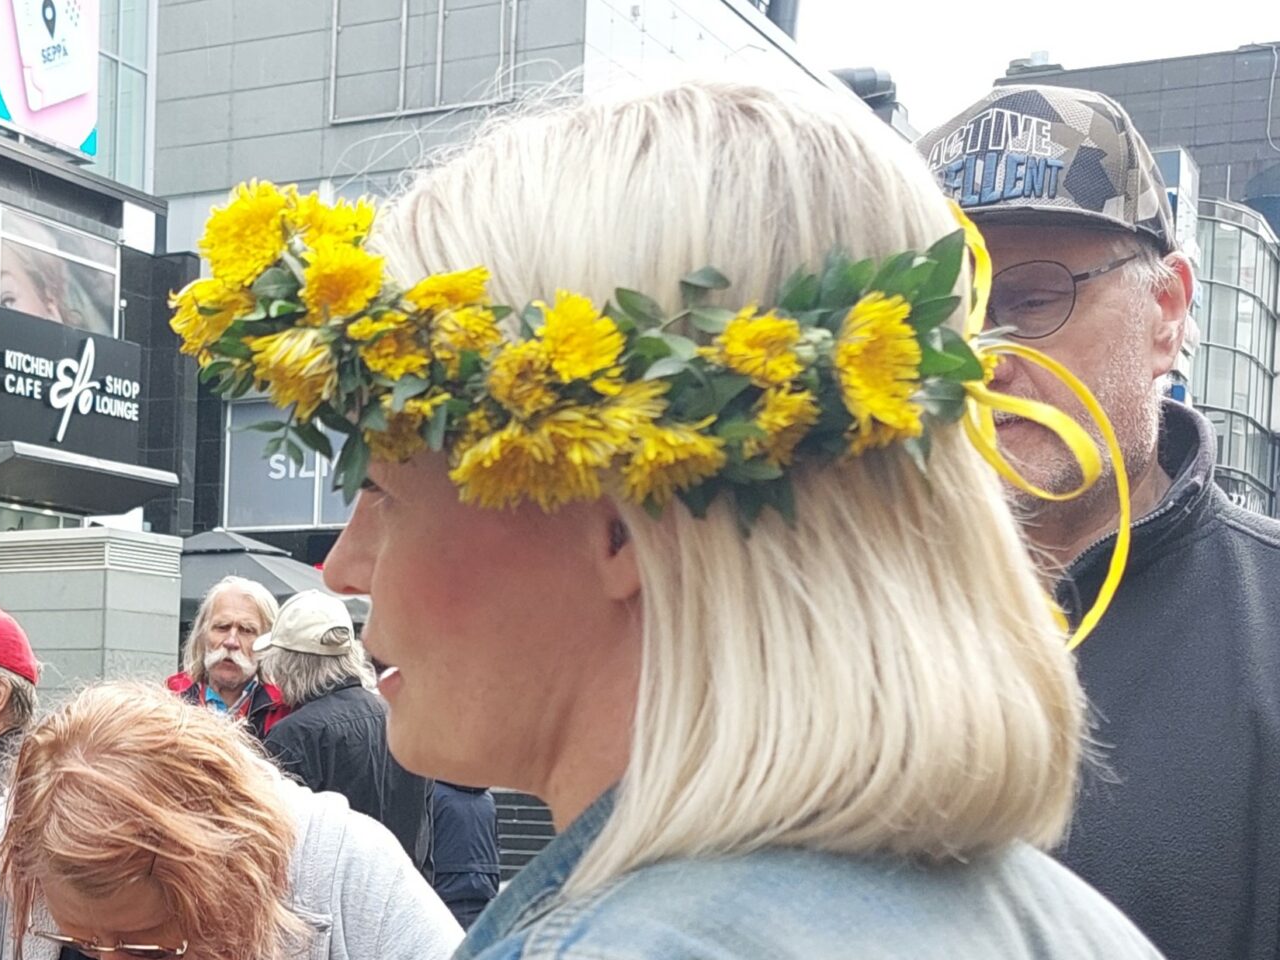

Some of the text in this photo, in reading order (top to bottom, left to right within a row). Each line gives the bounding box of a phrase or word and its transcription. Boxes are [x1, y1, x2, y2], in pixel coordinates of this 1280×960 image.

[4, 349, 55, 379] KITCHEN
[4, 373, 42, 400] CAFE
[105, 374, 140, 400] SHOP
[95, 394, 140, 422] LOUNGE
